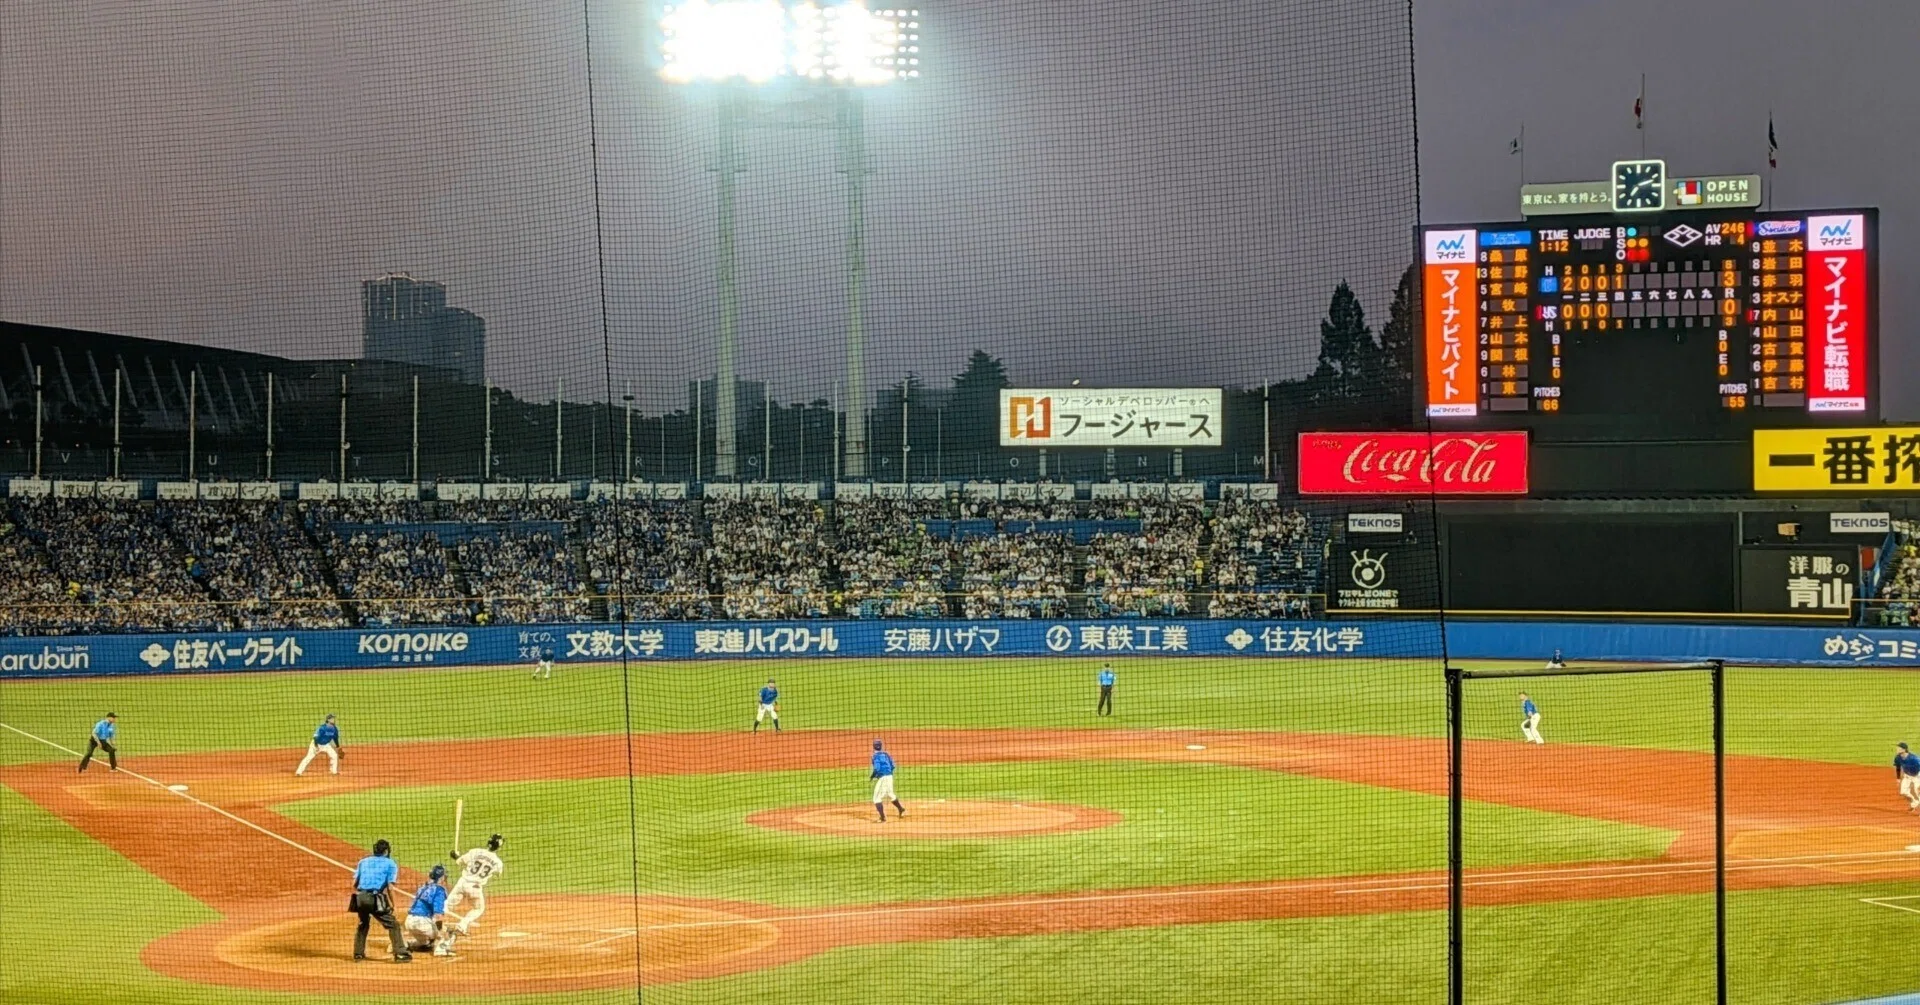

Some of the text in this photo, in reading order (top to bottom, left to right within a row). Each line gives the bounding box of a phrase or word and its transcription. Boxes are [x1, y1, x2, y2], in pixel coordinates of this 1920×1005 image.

[1707, 180, 1748, 191] OPEN
[1522, 192, 1612, 206] 東京に、家を持とう。
[1707, 192, 1748, 203] HOUSE
[1574, 228, 1611, 239] JUDGE
[1616, 227, 1625, 238] B
[1705, 223, 1744, 234] AV 246
[1539, 230, 1569, 240] TIME
[1705, 234, 1744, 245] HR 4
[1540, 241, 1568, 252] 1:12
[1616, 239, 1625, 249] S
[1752, 241, 1760, 253] 9
[1820, 238, 1852, 246] マイナビ
[1436, 251, 1466, 260] マイナビ
[1480, 251, 1487, 262] 8
[1544, 265, 1553, 276] H
[1564, 265, 1572, 275] 2
[1581, 264, 1589, 274] 0
[1599, 264, 1605, 274] 1
[1615, 263, 1623, 273] 3
[1752, 258, 1760, 270] 8
[1480, 268, 1488, 278] 3
[1563, 271, 1735, 291] 2 0 0 1 3
[1752, 275, 1760, 287] 5
[1480, 284, 1487, 295] 5
[1631, 291, 1642, 300] 五
[1649, 290, 1660, 300] 六
[1666, 289, 1677, 299] 七
[1683, 289, 1695, 299] 八
[1701, 288, 1713, 299] 九
[1725, 288, 1735, 298] R
[1752, 291, 1803, 304] 3 オスナ
[1480, 301, 1487, 311] 4
[1563, 304, 1573, 318] 0
[1581, 304, 1590, 318] 0
[1597, 304, 1607, 317] 0
[1725, 299, 1735, 314] 0
[1753, 308, 1804, 321] 7 内山
[1480, 315, 1528, 328] 7 井上
[1545, 321, 1553, 331] H
[1565, 321, 1571, 330] 1
[1583, 320, 1588, 330] 1
[1599, 320, 1606, 329] 0
[1616, 320, 1623, 329] 1
[1824, 257, 1850, 391] マイナビ転職
[1441, 269, 1461, 400] マイナビバイト
[1719, 330, 1727, 340] B
[1752, 325, 1804, 338] 4 山田
[1480, 332, 1528, 345] 2 山本
[1552, 334, 1560, 344] B
[1553, 345, 1559, 355] 1
[1719, 341, 1727, 352] 0
[1752, 344, 1761, 355] 2
[1481, 350, 1488, 361] 9
[1719, 353, 1728, 365] E
[1552, 357, 1560, 367] E
[1752, 361, 1761, 372] 6
[1481, 367, 1488, 377] 6
[1552, 368, 1560, 378] 0
[1719, 365, 1728, 376] 0
[1481, 383, 1487, 394] 1
[1719, 384, 1747, 394] PITCHES
[1754, 378, 1760, 389] 1
[1534, 387, 1561, 398] PITCHES
[1543, 400, 1559, 411] 66
[1729, 396, 1745, 408] 55
[1059, 409, 1212, 438] フージャース
[61, 453, 70, 463] V
[208, 455, 217, 465] U
[353, 457, 361, 467] T
[492, 455, 500, 465] S
[635, 456, 643, 466] R
[881, 457, 889, 467] P
[1138, 456, 1147, 466] N
[1253, 456, 1263, 465] M
[1350, 519, 1401, 528] TEKNOS
[1832, 518, 1888, 527] TEKNOS
[1789, 555, 1850, 575] 洋服の
[1786, 576, 1853, 608] 青山
[518, 631, 556, 644] 育ての、
[566, 628, 664, 657] 文教大学
[695, 628, 839, 653] 東進ハイスクール
[884, 626, 1000, 652] 安藤ハザマ
[1080, 624, 1188, 651] 東鉄工業
[1260, 626, 1363, 652] 住友化学
[1824, 634, 1920, 659] めちゃコミ
[0, 646, 89, 670] arubun
[173, 637, 303, 669] 住友ベークライト
[470, 860, 491, 879] 33
